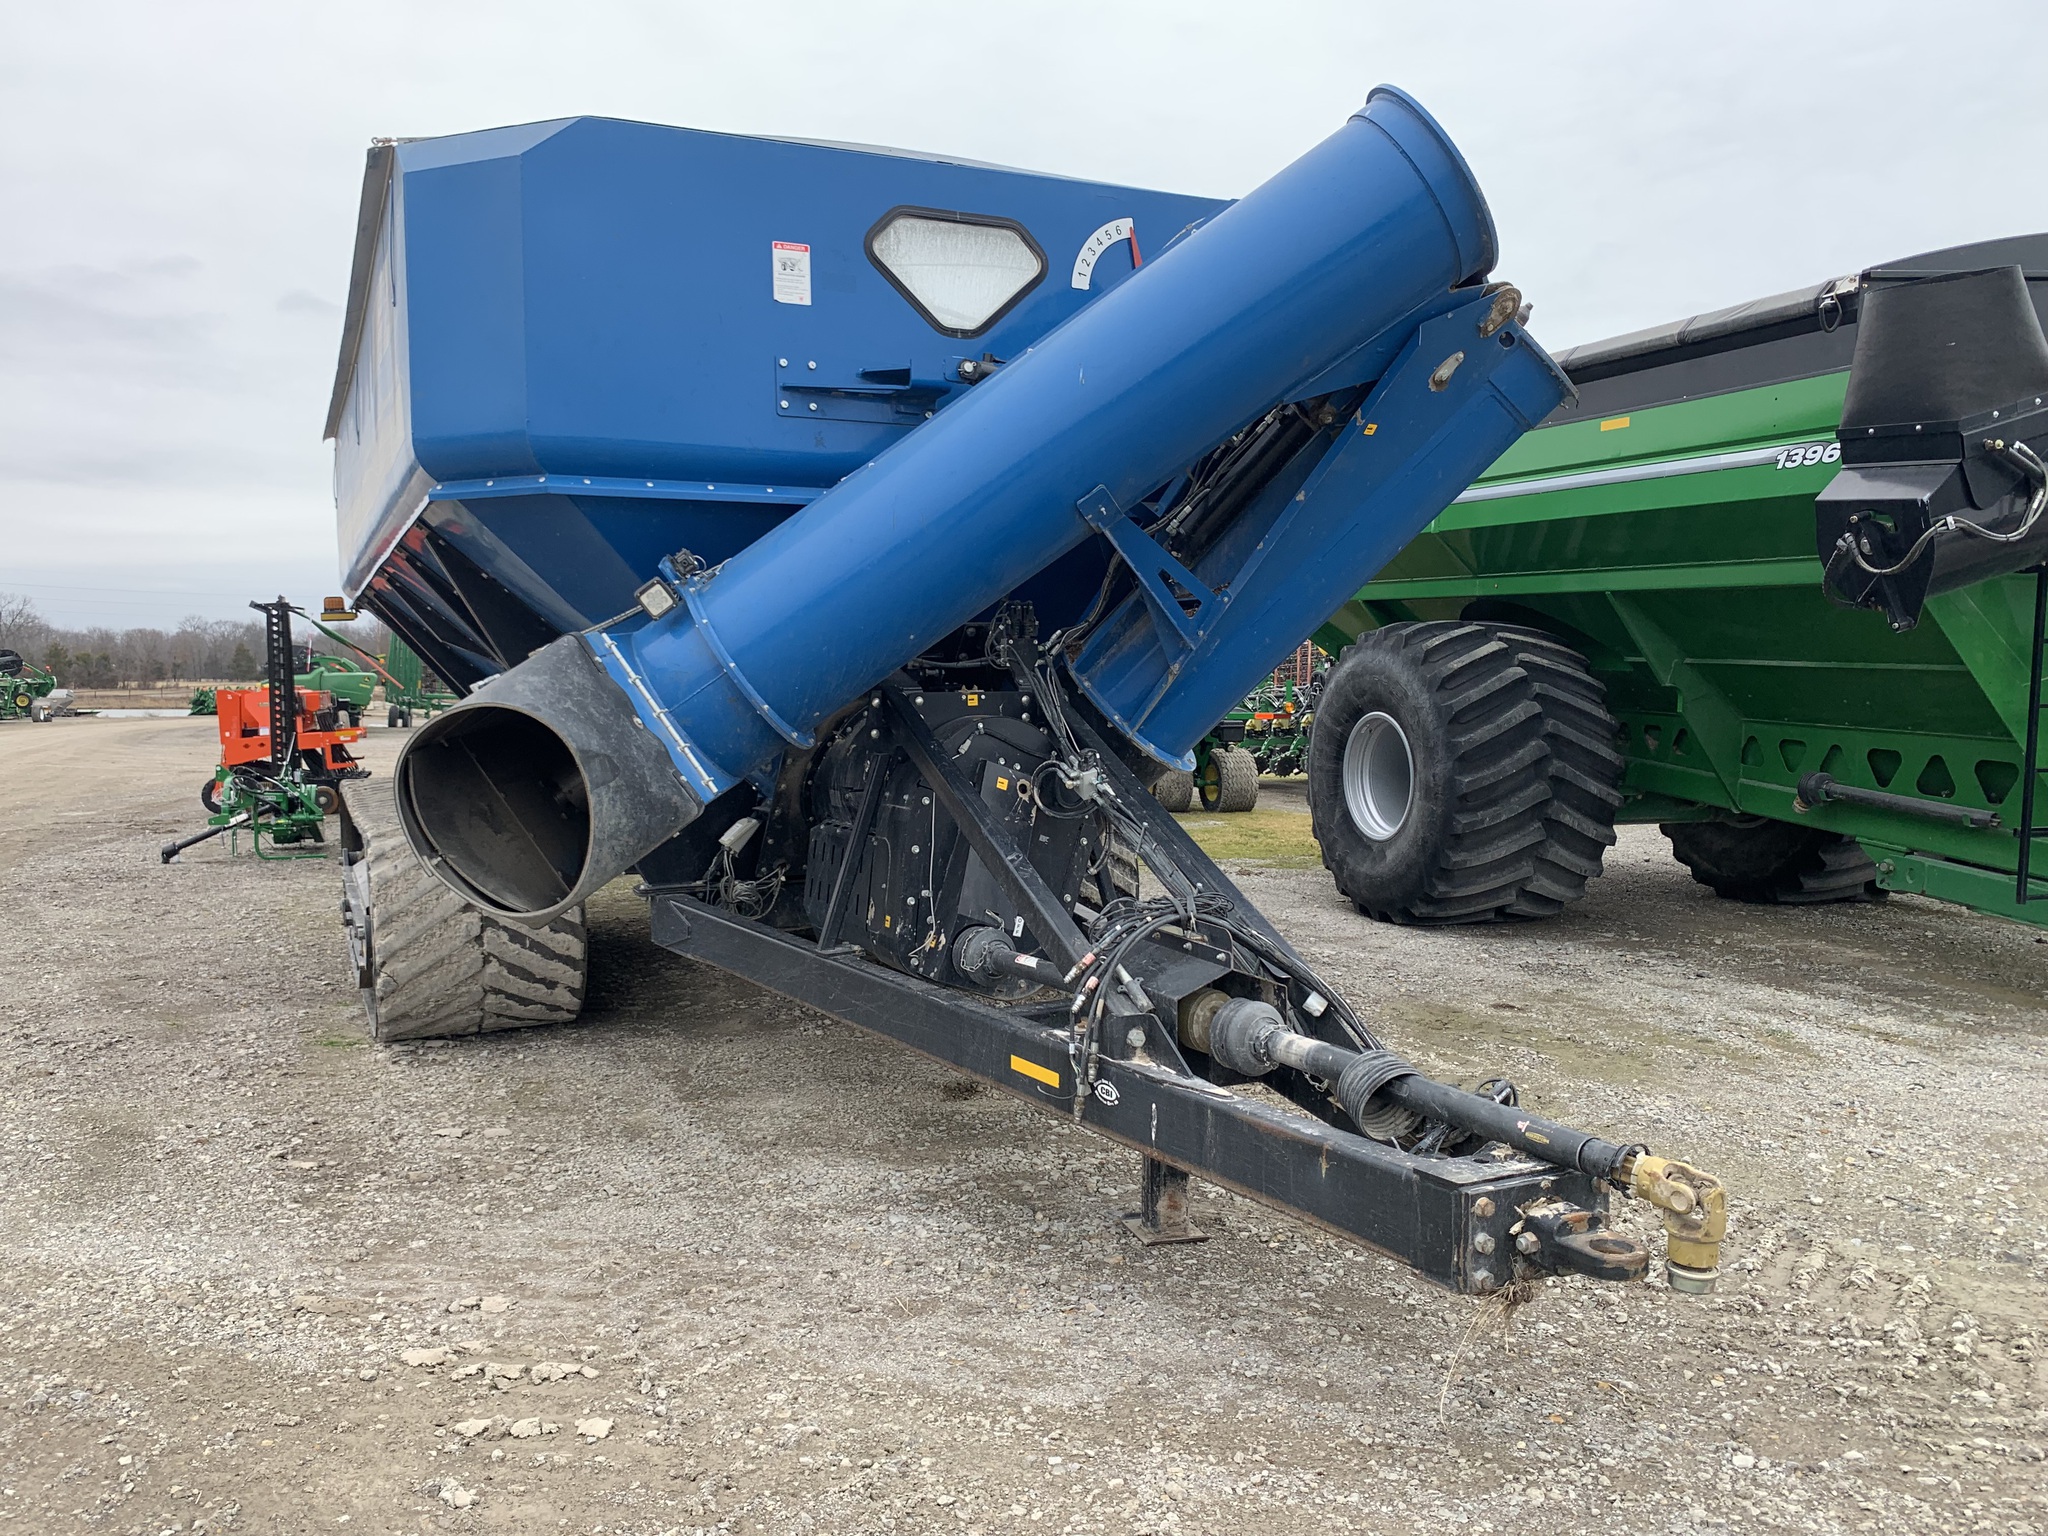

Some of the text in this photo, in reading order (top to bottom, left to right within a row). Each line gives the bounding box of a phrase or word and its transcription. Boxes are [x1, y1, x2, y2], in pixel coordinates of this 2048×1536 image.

[783, 244, 806, 252] DANGER
[1081, 258, 1091, 267] 2
[1087, 247, 1096, 256] 3
[1096, 237, 1104, 246] 4
[1104, 229, 1112, 240] 5
[1115, 225, 1122, 236] 6
[1775, 442, 1841, 470] 1396
[1100, 1086, 1114, 1099] CBI
